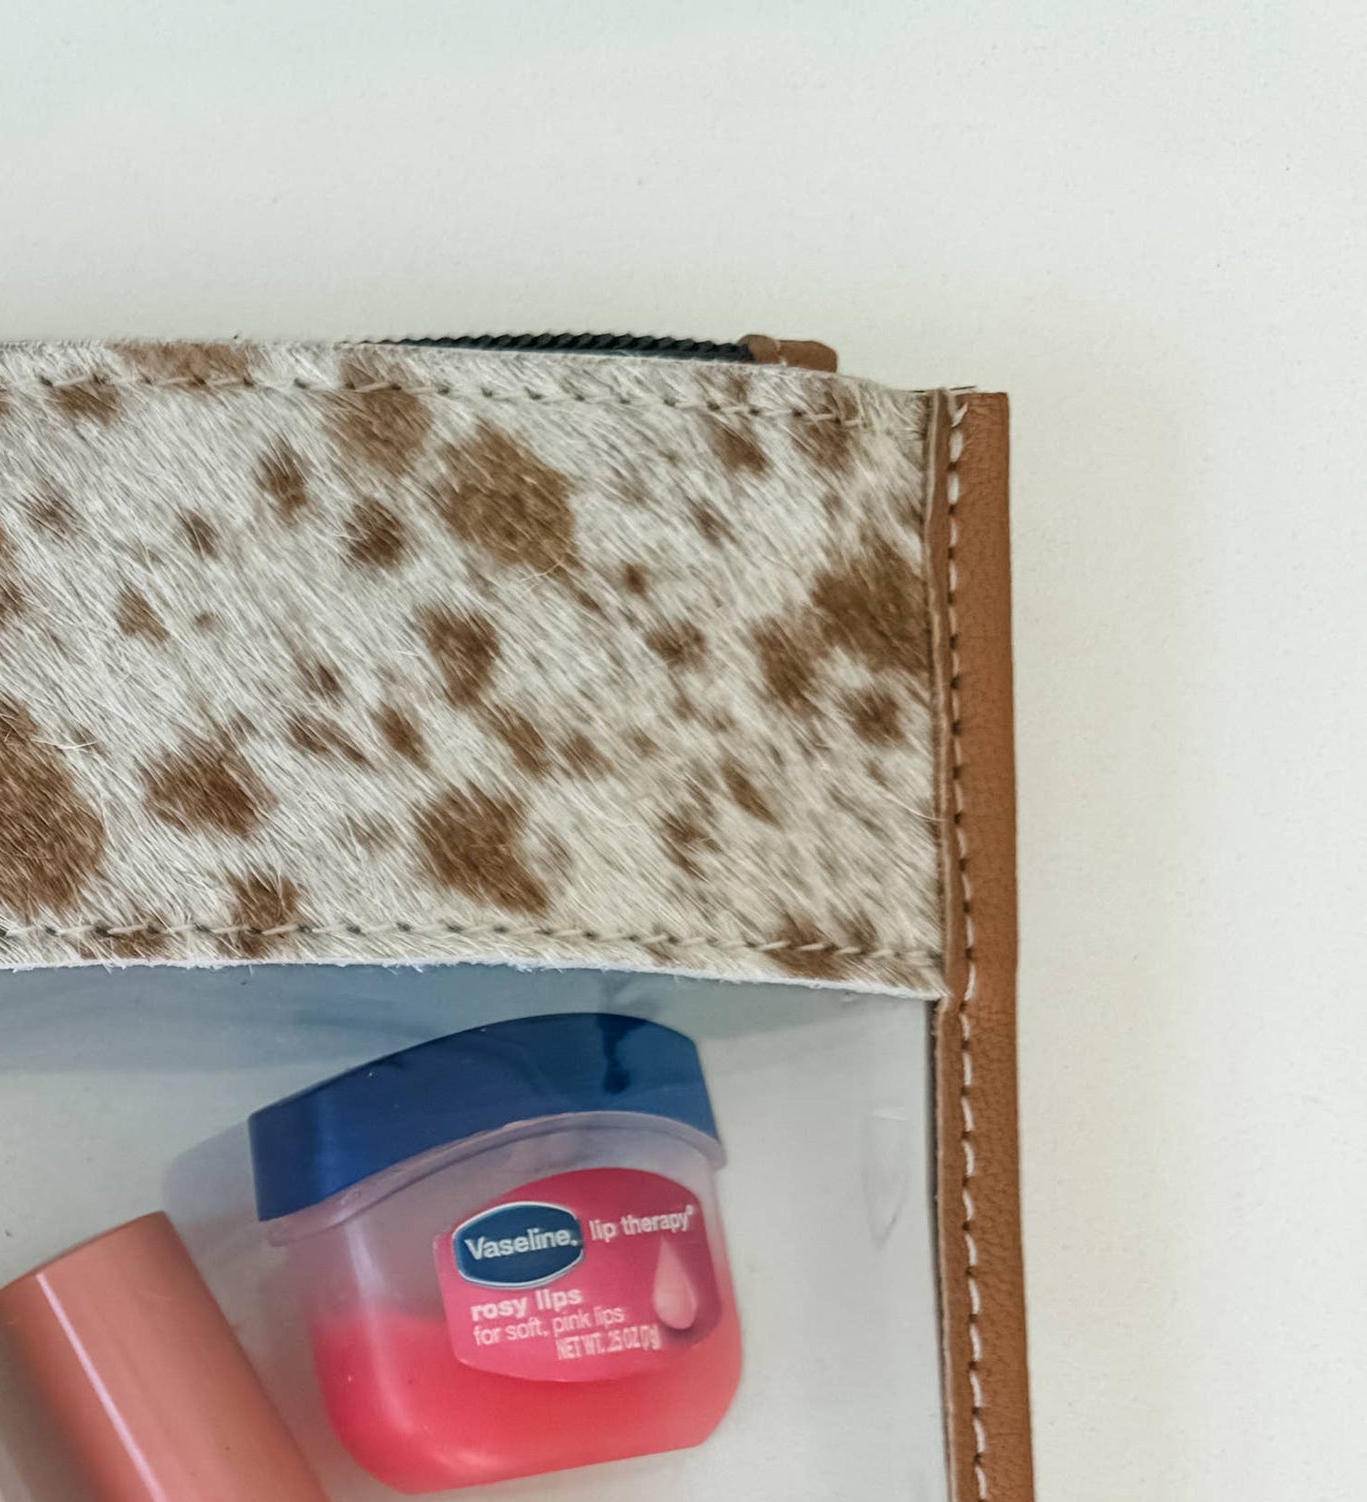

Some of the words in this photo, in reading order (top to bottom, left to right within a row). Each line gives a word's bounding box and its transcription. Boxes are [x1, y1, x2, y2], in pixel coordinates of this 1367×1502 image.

[589, 1219, 617, 1242] lip
[470, 1297, 527, 1323] rosy
[535, 1287, 583, 1312] lips
[473, 1325, 501, 1346] for
[552, 1310, 592, 1337] pink
[594, 1305, 626, 1327] lips
[555, 1336, 582, 1360] NET
